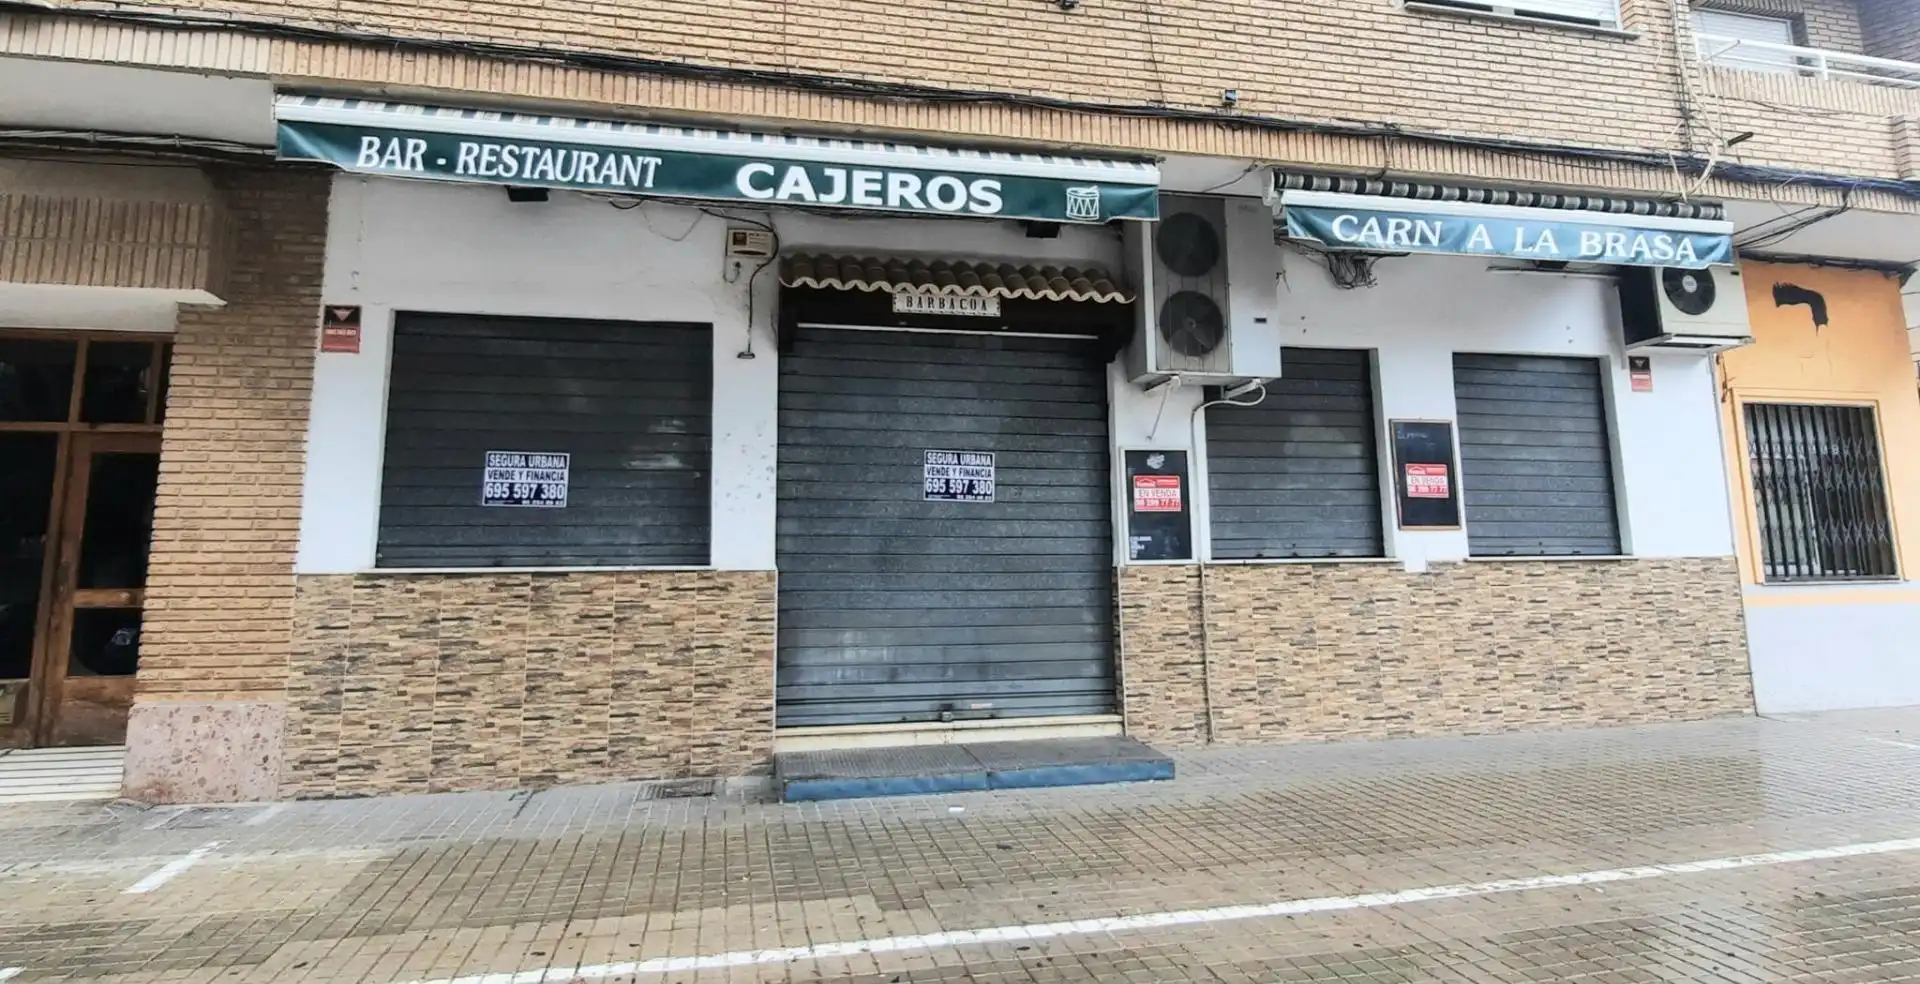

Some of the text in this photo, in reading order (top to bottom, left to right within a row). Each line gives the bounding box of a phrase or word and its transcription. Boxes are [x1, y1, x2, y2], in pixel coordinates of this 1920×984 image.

[356, 135, 428, 172] BAR
[455, 141, 662, 188] RESTAURANT
[735, 162, 1004, 214] CAJEROS
[1331, 214, 1699, 263] CARN A LA BRASA
[905, 295, 988, 311] BARBACOA
[489, 454, 565, 468] SEGURA URBANA
[926, 452, 992, 466] SEGURA URBANA
[487, 469, 565, 480] VENDE Y FINANCIA
[926, 466, 992, 478] VENDE Y FINANCIA
[486, 482, 565, 500] 695 597 380
[926, 479, 992, 495] 695 597 380
